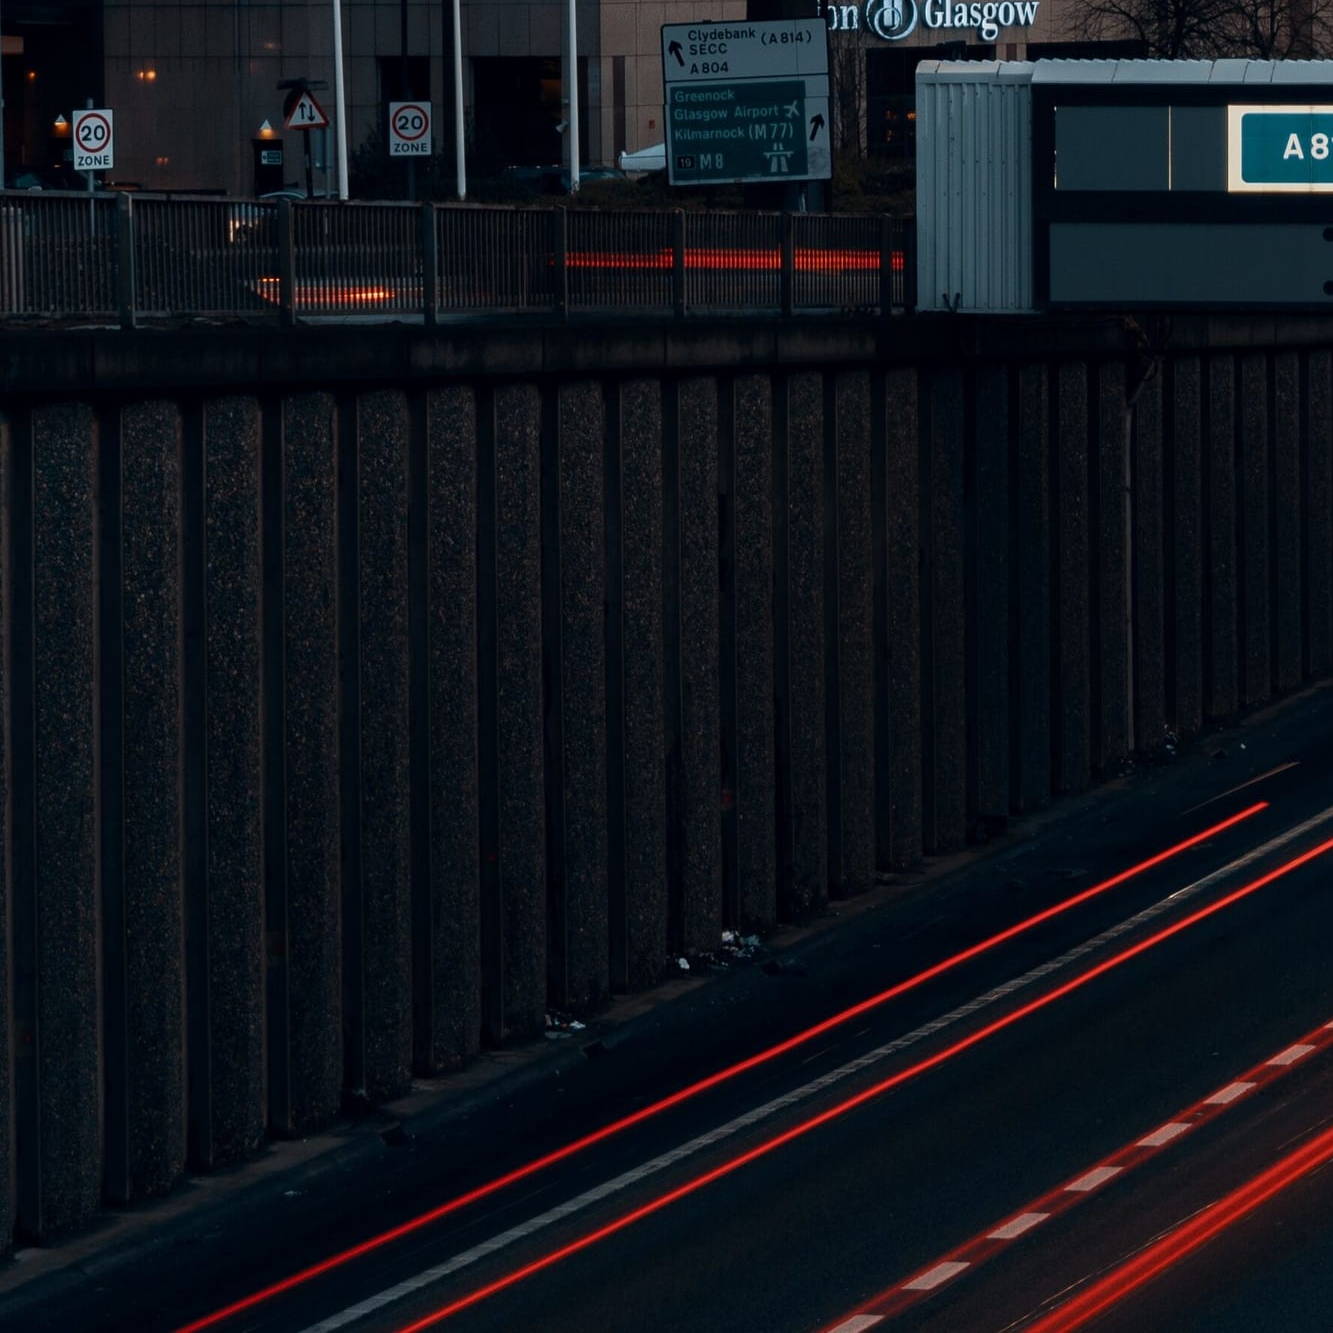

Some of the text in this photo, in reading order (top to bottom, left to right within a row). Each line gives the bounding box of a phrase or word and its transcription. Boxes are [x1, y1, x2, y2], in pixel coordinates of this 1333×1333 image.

[688, 28, 756, 42] Clydebank
[689, 43, 728, 55] SECC
[675, 89, 735, 103] Greenock
[674, 104, 779, 122] Glasgow Airport
[398, 115, 423, 130] 20
[81, 125, 105, 141] 20
[674, 126, 745, 141] Kilmarnock
[394, 142, 428, 153] ZONE
[78, 155, 110, 166] ZONE
[679, 157, 693, 168] 19
